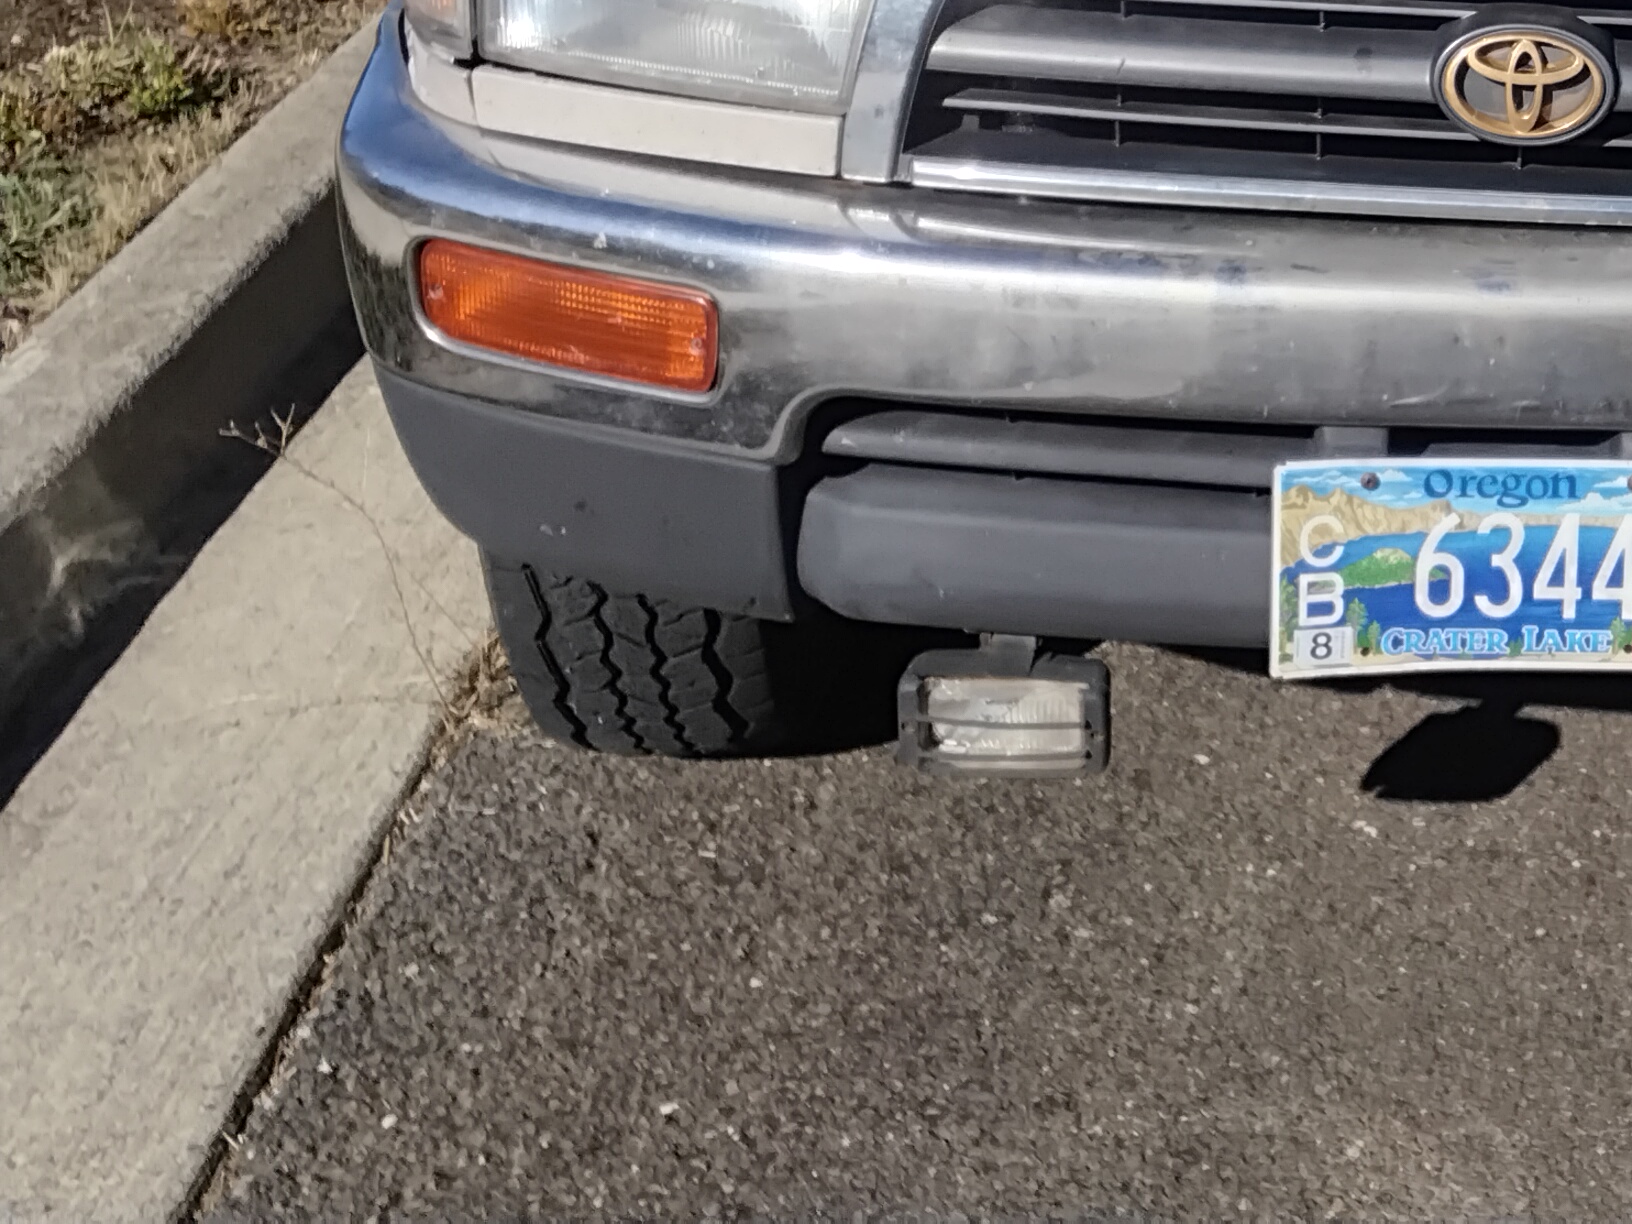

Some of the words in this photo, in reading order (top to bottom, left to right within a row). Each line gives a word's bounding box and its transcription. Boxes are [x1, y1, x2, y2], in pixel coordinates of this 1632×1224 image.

[1423, 469, 1579, 508] Oregon
[1310, 632, 1333, 660] 8
[1380, 628, 1509, 657] CRATER
[1521, 624, 1613, 654] LAKE
